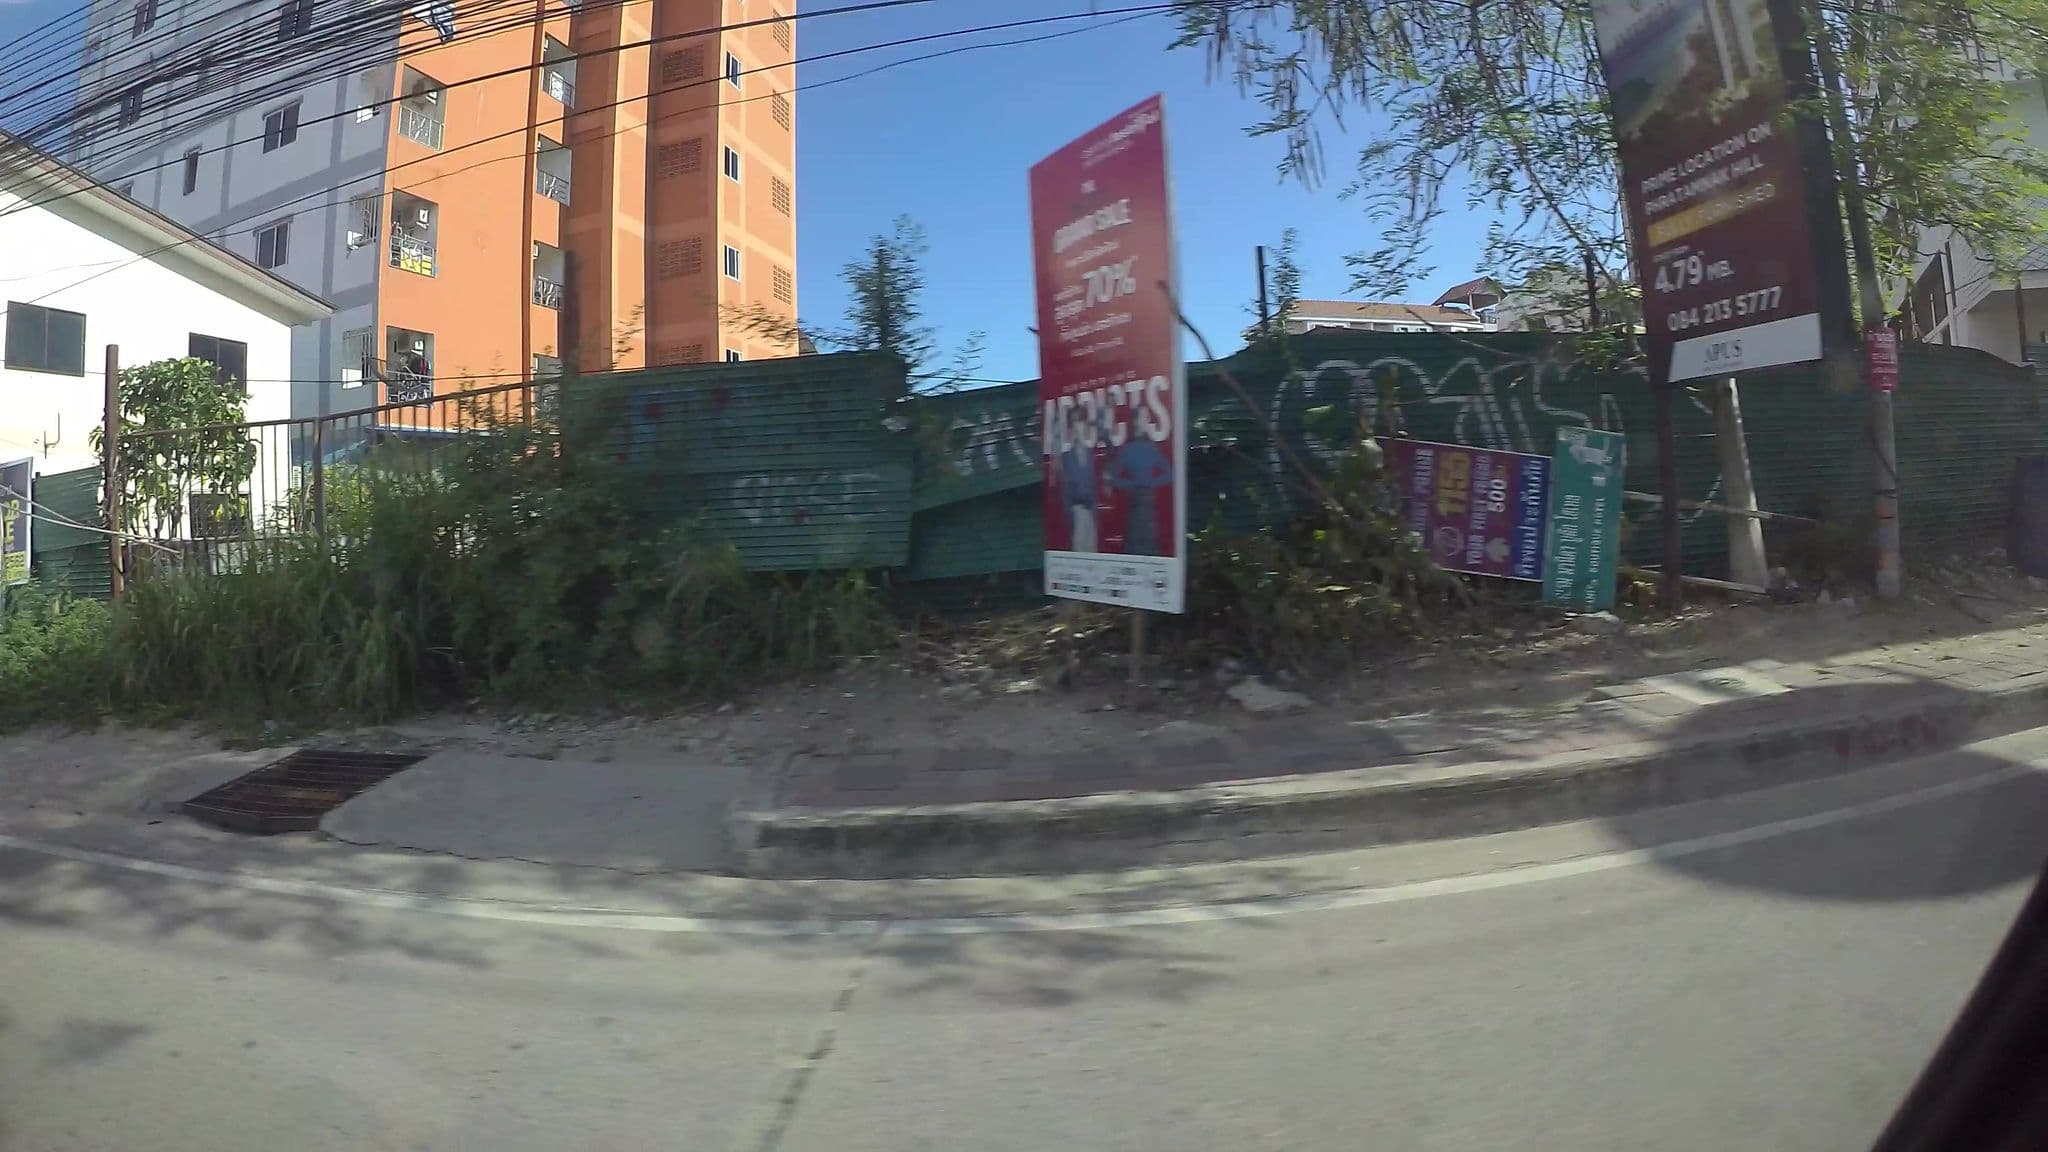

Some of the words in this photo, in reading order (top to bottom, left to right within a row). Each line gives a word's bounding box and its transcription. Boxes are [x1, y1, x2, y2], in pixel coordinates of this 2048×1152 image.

[1677, 133, 1746, 177] LOCATION
[1746, 121, 1772, 143] ON
[1082, 255, 1139, 308] 70%
[1703, 298, 1732, 324] 213
[1734, 285, 1781, 316] 5777
[1486, 478, 1507, 513] 500
